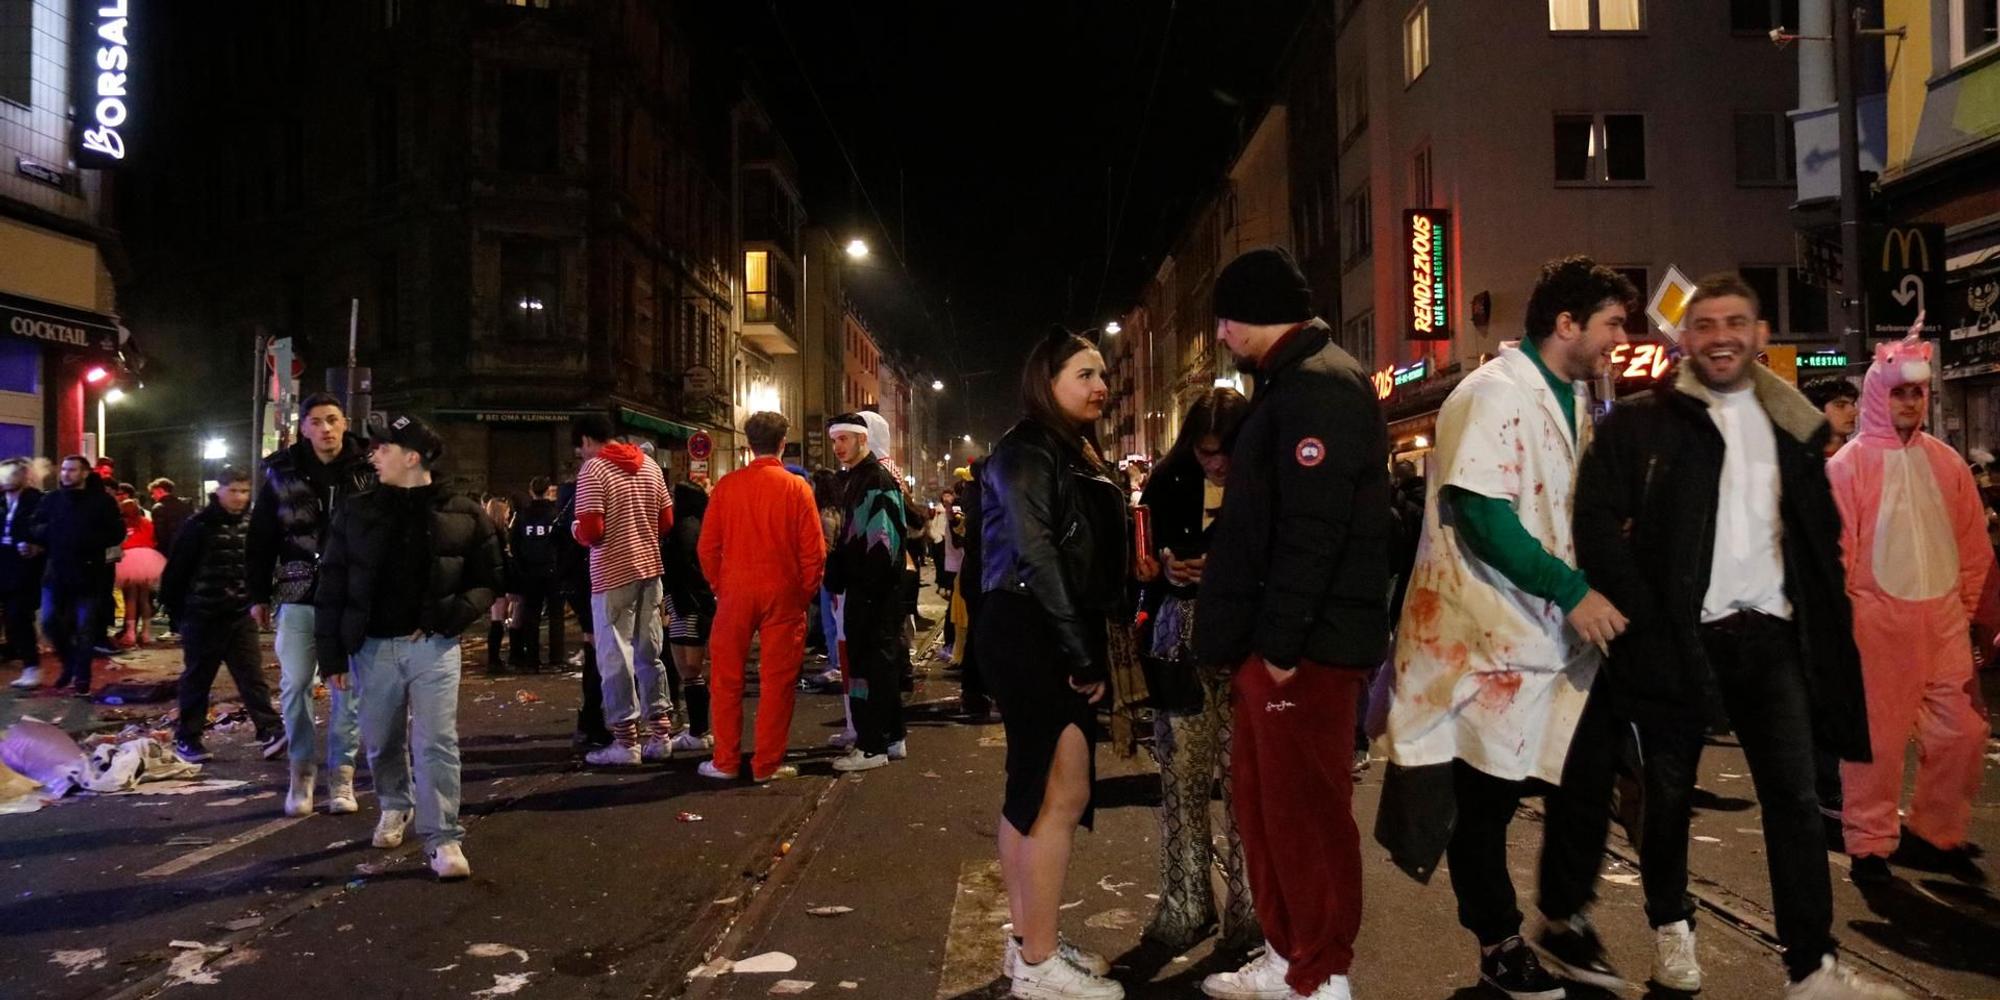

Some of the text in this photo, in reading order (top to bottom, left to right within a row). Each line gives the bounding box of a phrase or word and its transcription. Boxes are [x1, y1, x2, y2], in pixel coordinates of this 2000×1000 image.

[1433, 225, 1443, 276] RESTAURANT
[1413, 215, 1431, 333] RENDEZVOUS
[1434, 283, 1443, 299] BAR
[10, 316, 89, 347] COCKTAIL
